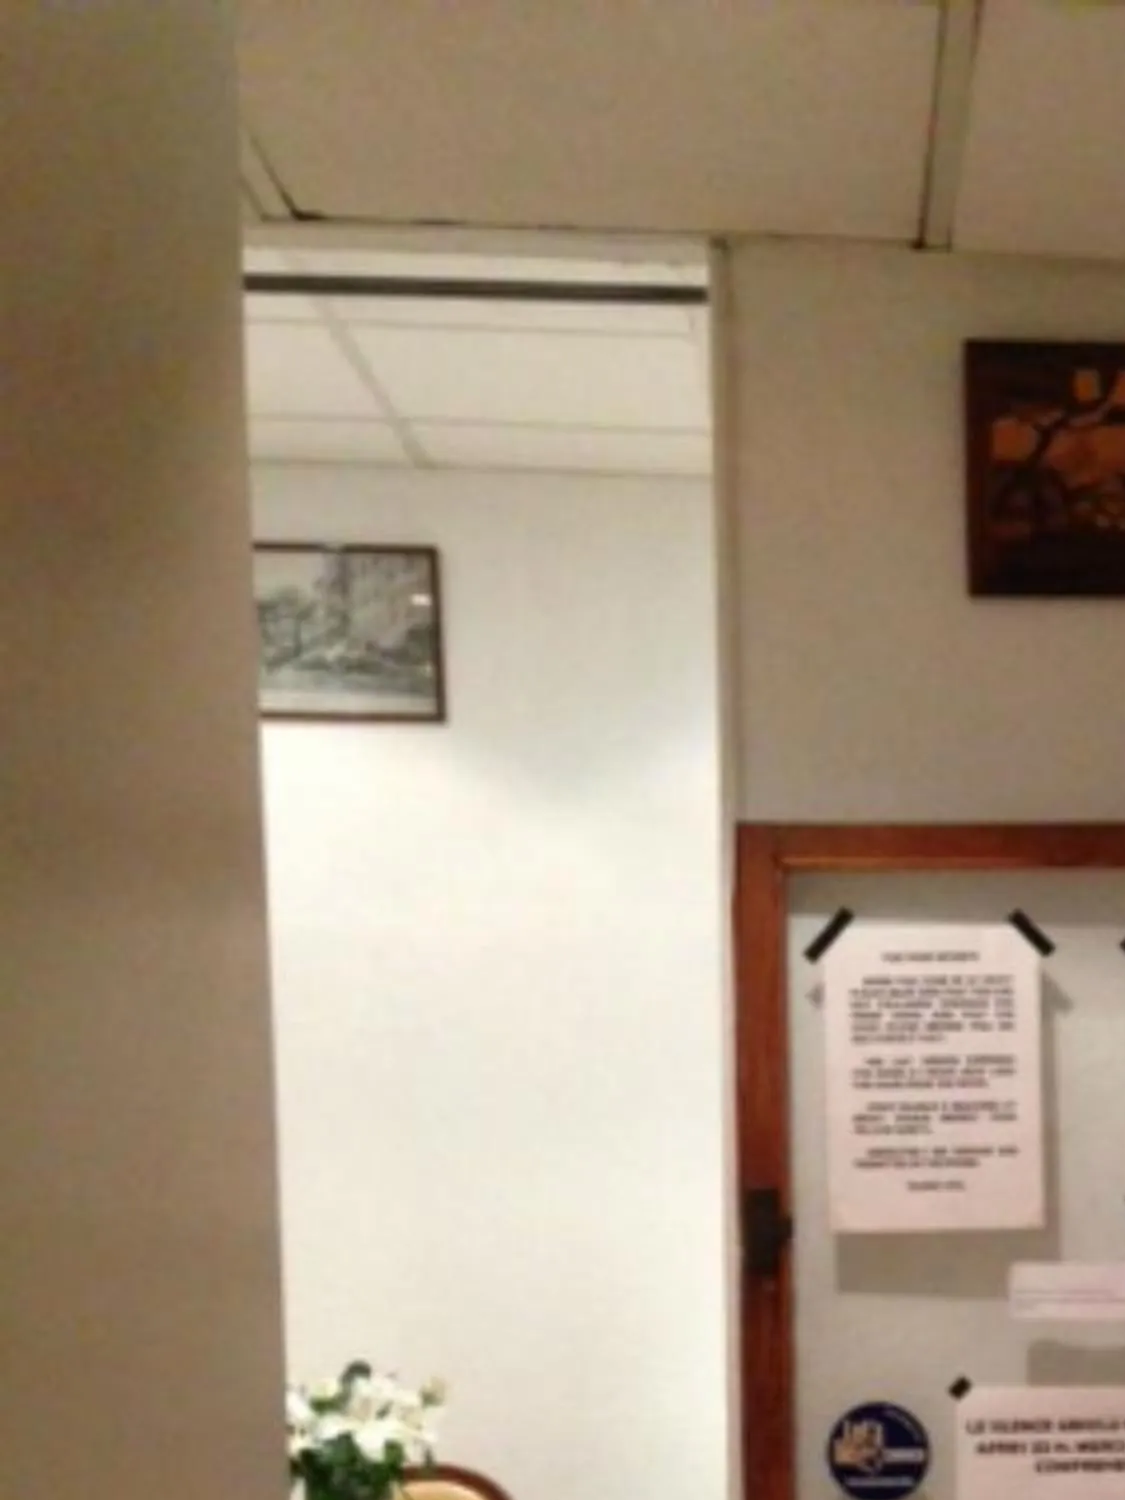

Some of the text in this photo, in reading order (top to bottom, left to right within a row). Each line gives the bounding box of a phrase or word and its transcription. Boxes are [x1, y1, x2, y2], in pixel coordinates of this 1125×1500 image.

[990, 1419, 1053, 1434] SILENCE
[1057, 1418, 1120, 1432] ABSOLU
[1076, 1439, 1125, 1453] MERCI
